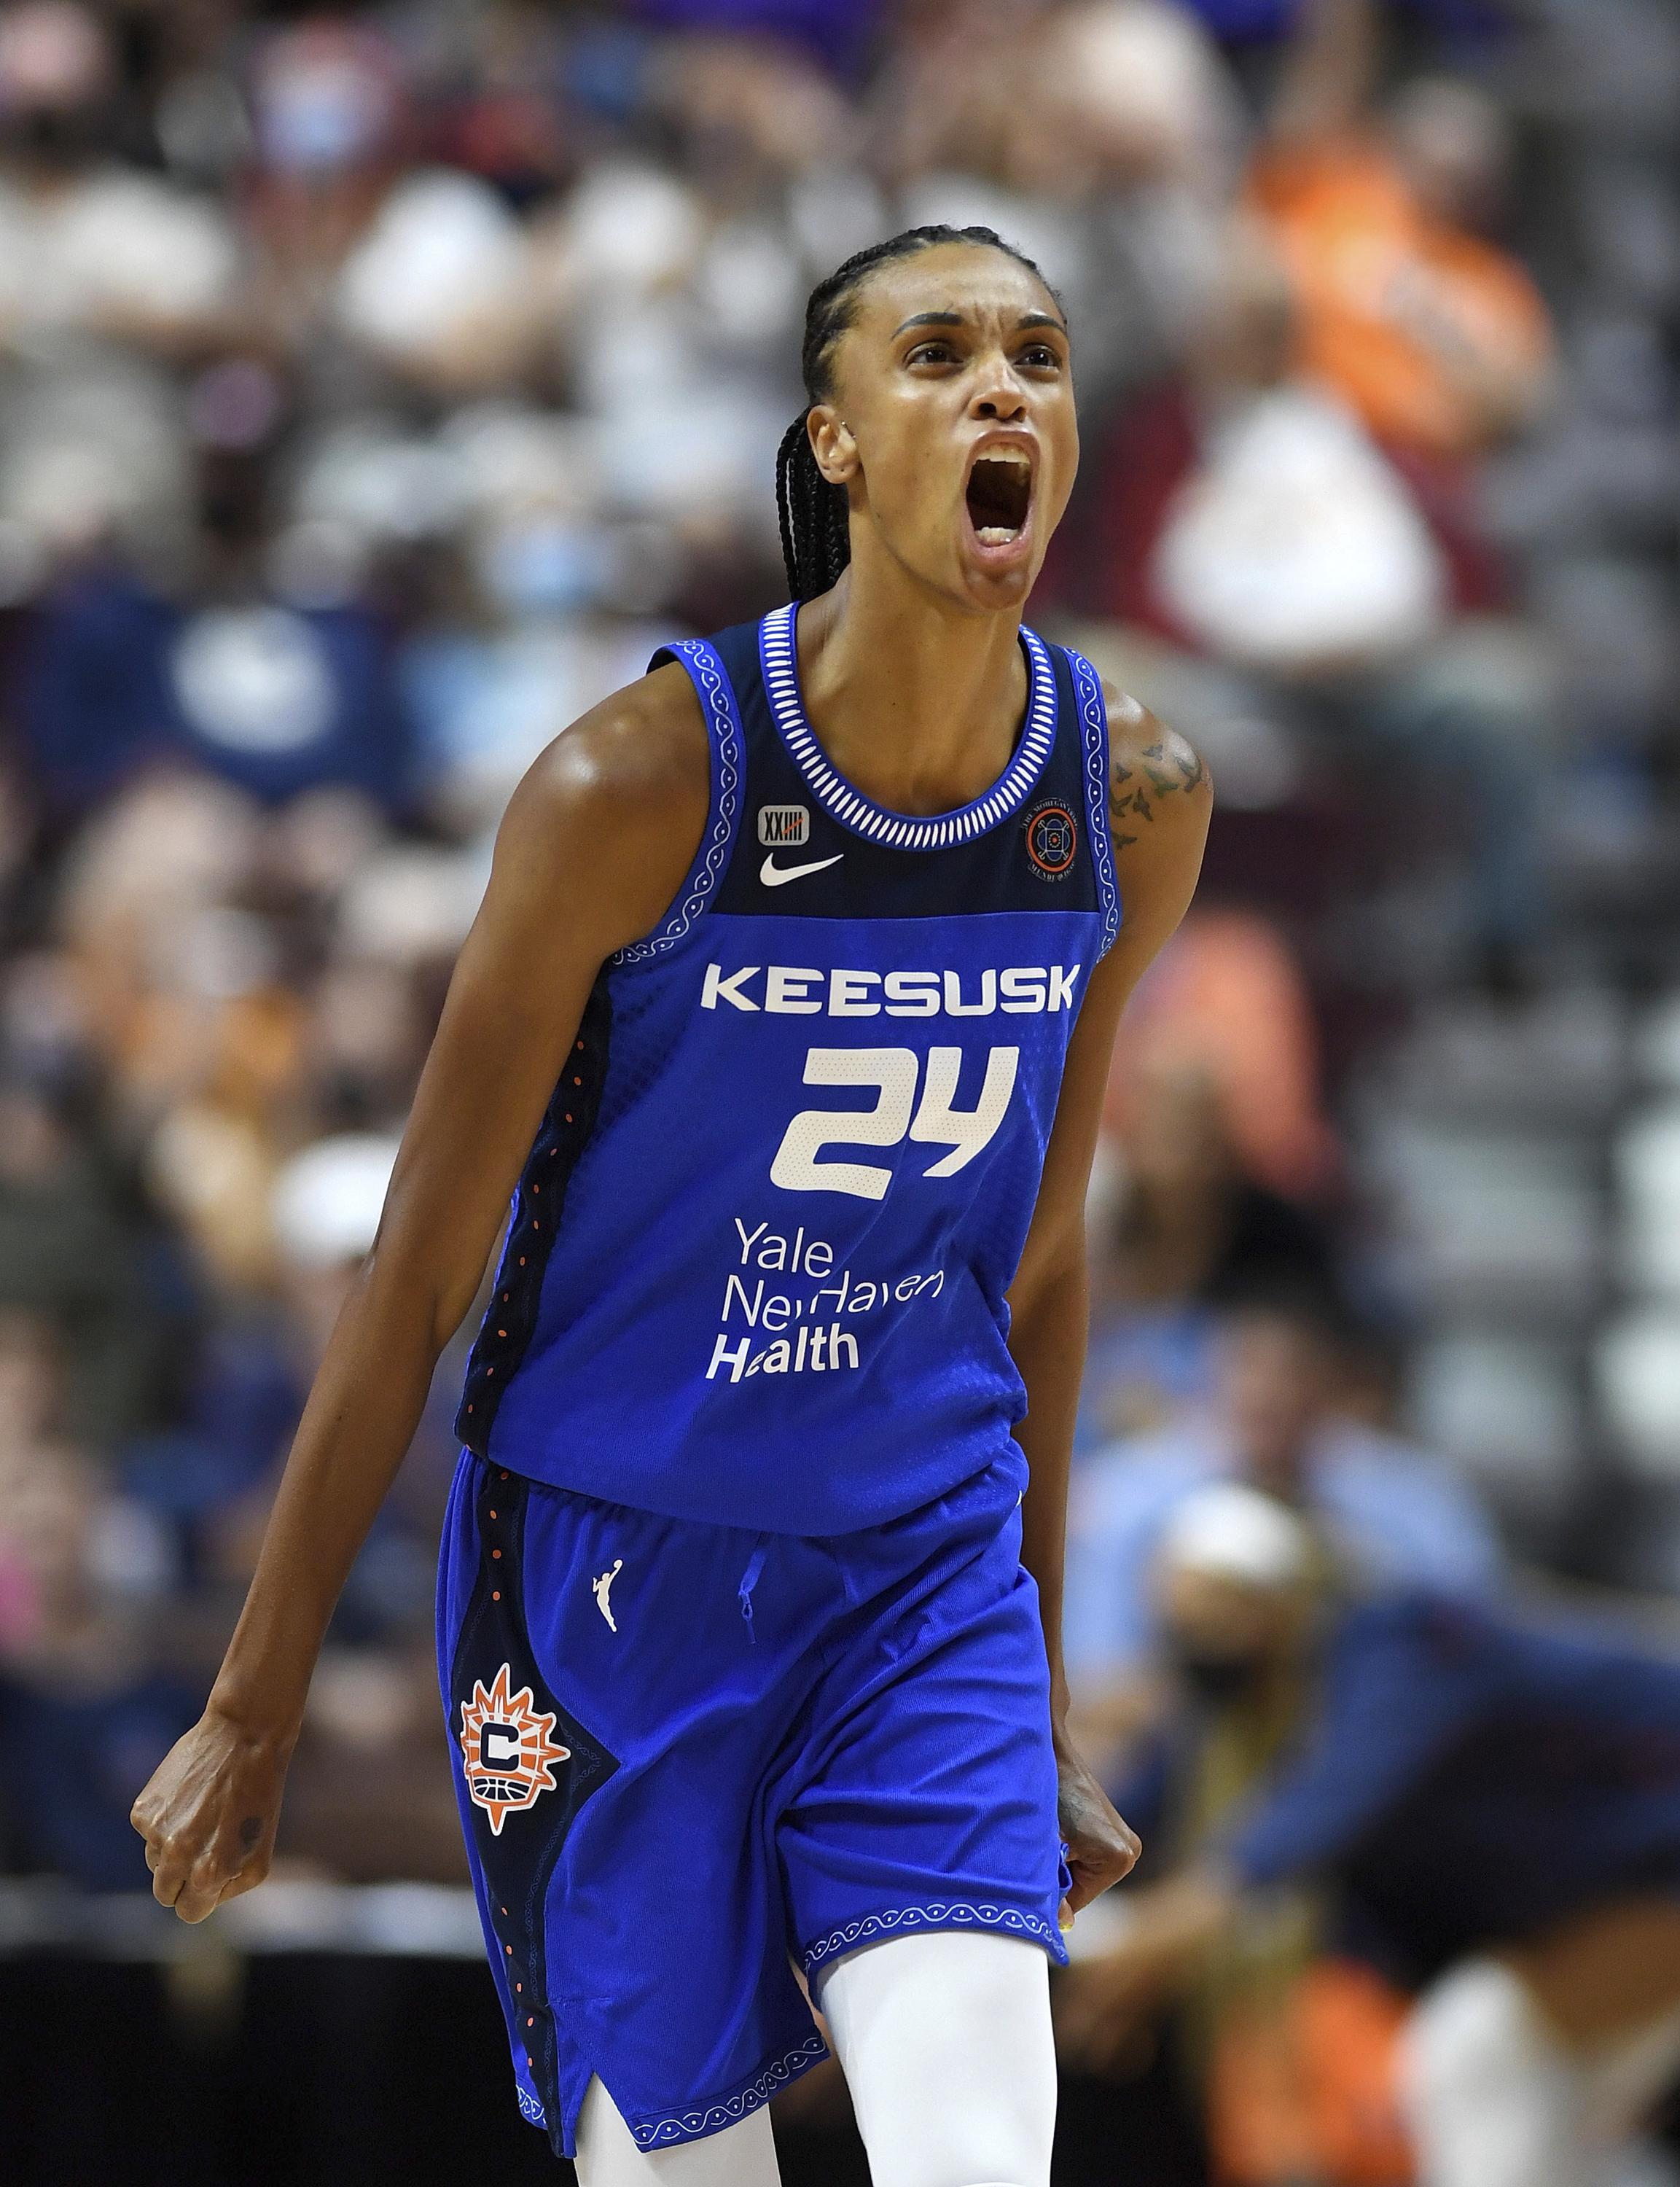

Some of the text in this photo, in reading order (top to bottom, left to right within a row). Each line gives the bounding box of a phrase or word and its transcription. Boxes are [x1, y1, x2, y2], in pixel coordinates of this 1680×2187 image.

[700, 963, 1081, 1017] KEESUSK
[770, 1046, 1020, 1201] 24
[735, 1217, 833, 1278] Yale
[705, 1322, 859, 1383] Health
[480, 1721, 520, 1772] C
